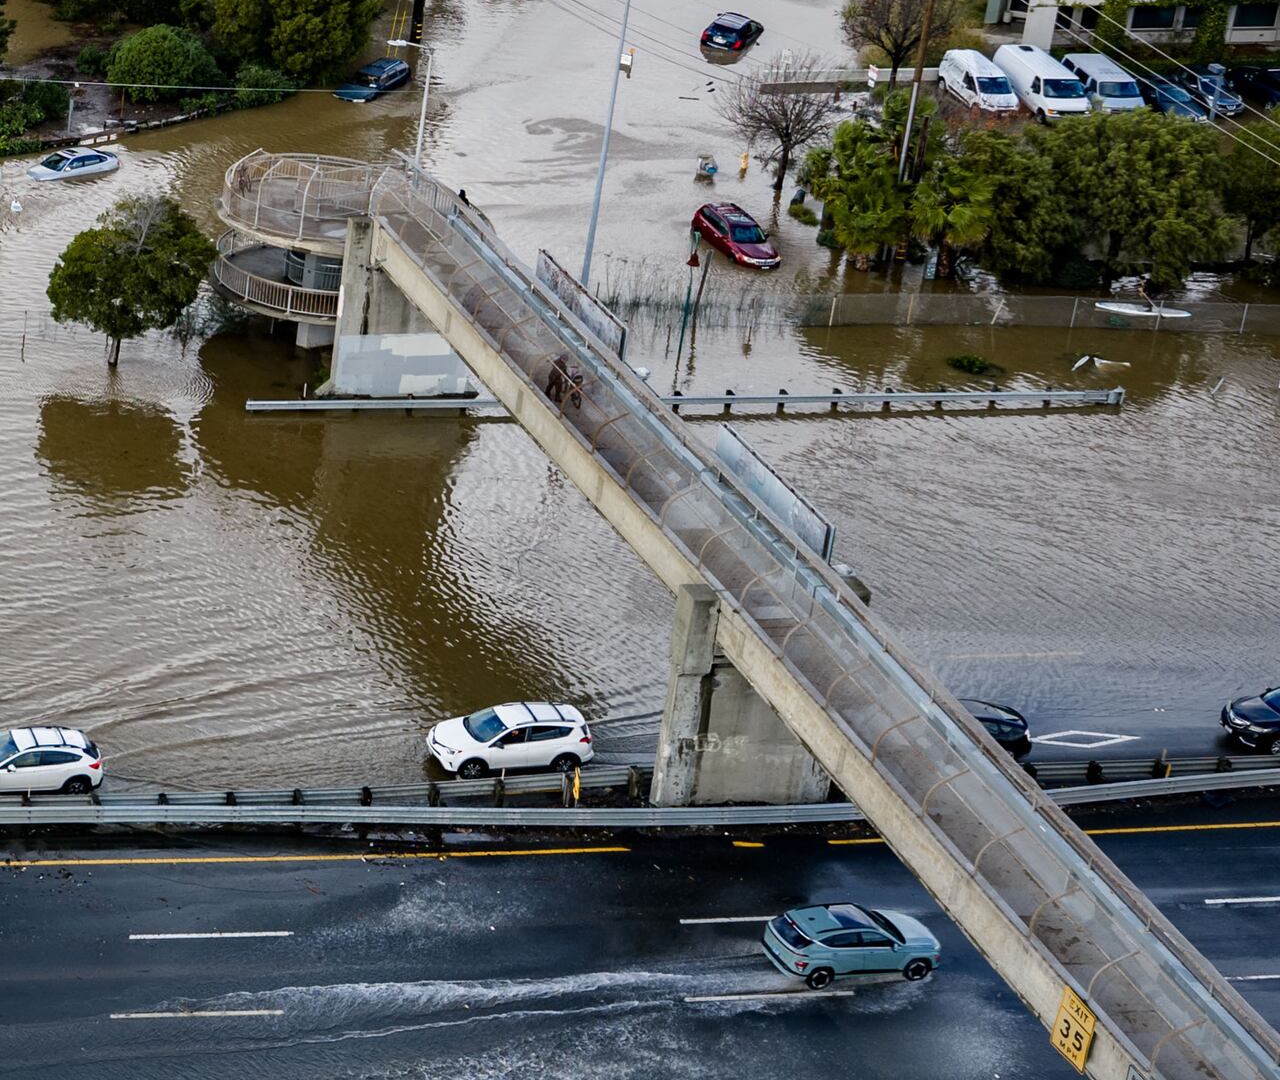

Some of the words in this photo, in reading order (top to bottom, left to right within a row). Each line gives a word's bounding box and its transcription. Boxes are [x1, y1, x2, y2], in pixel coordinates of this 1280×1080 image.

[1068, 999, 1089, 1024] EXIT
[1059, 1018, 1084, 1052] 35
[1059, 1039, 1078, 1061] MPH
